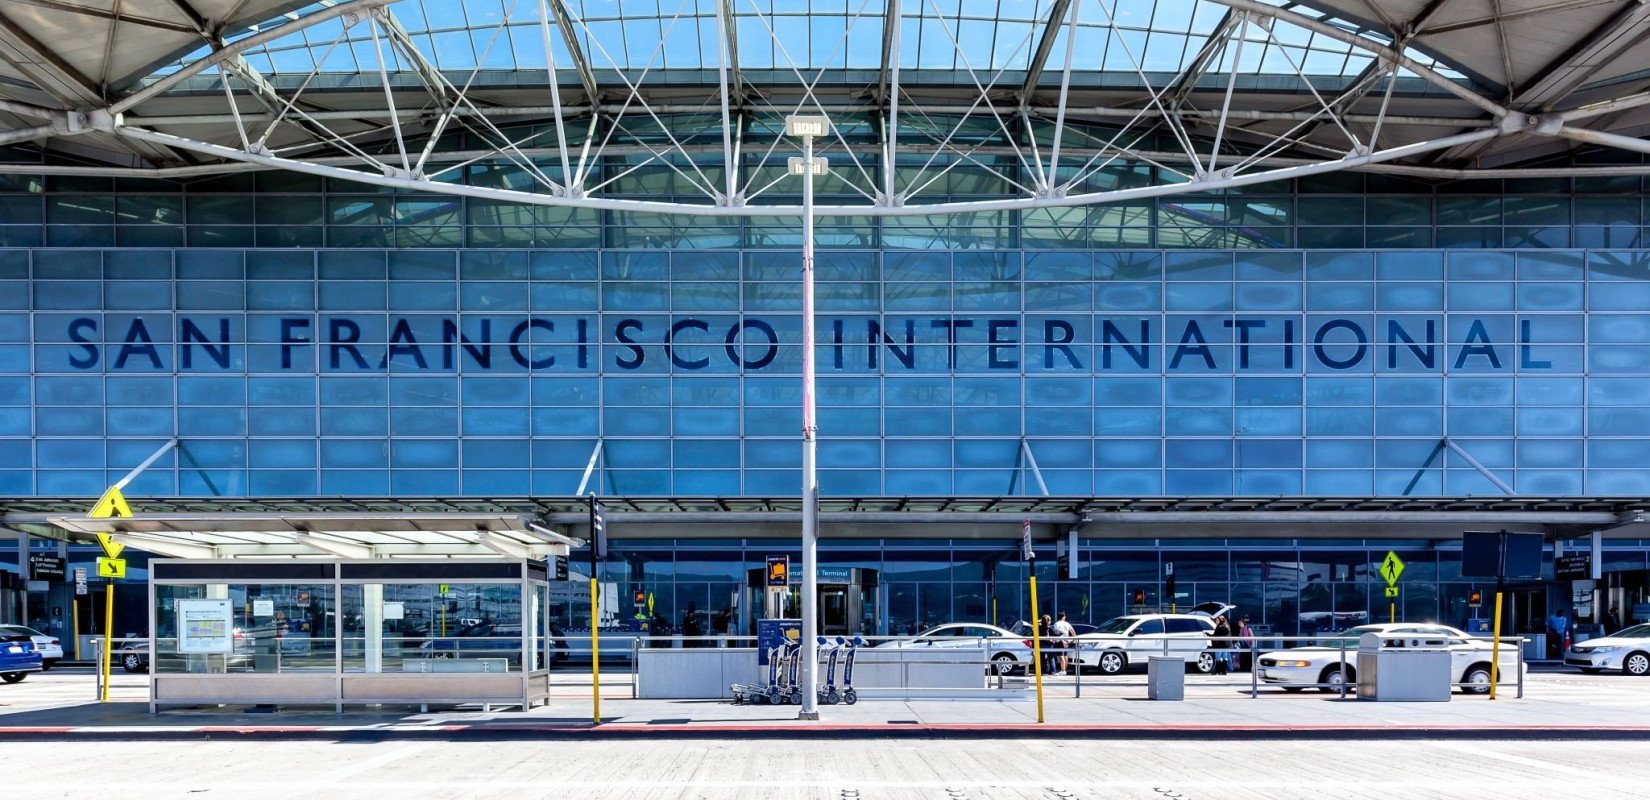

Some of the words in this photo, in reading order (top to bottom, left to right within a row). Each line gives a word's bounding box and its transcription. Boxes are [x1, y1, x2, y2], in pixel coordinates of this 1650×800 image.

[67, 317, 230, 370] SAN
[280, 317, 779, 370] FRANCISCO
[833, 318, 1553, 370] INTERNATIONAL
[821, 569, 848, 577] Terminal
